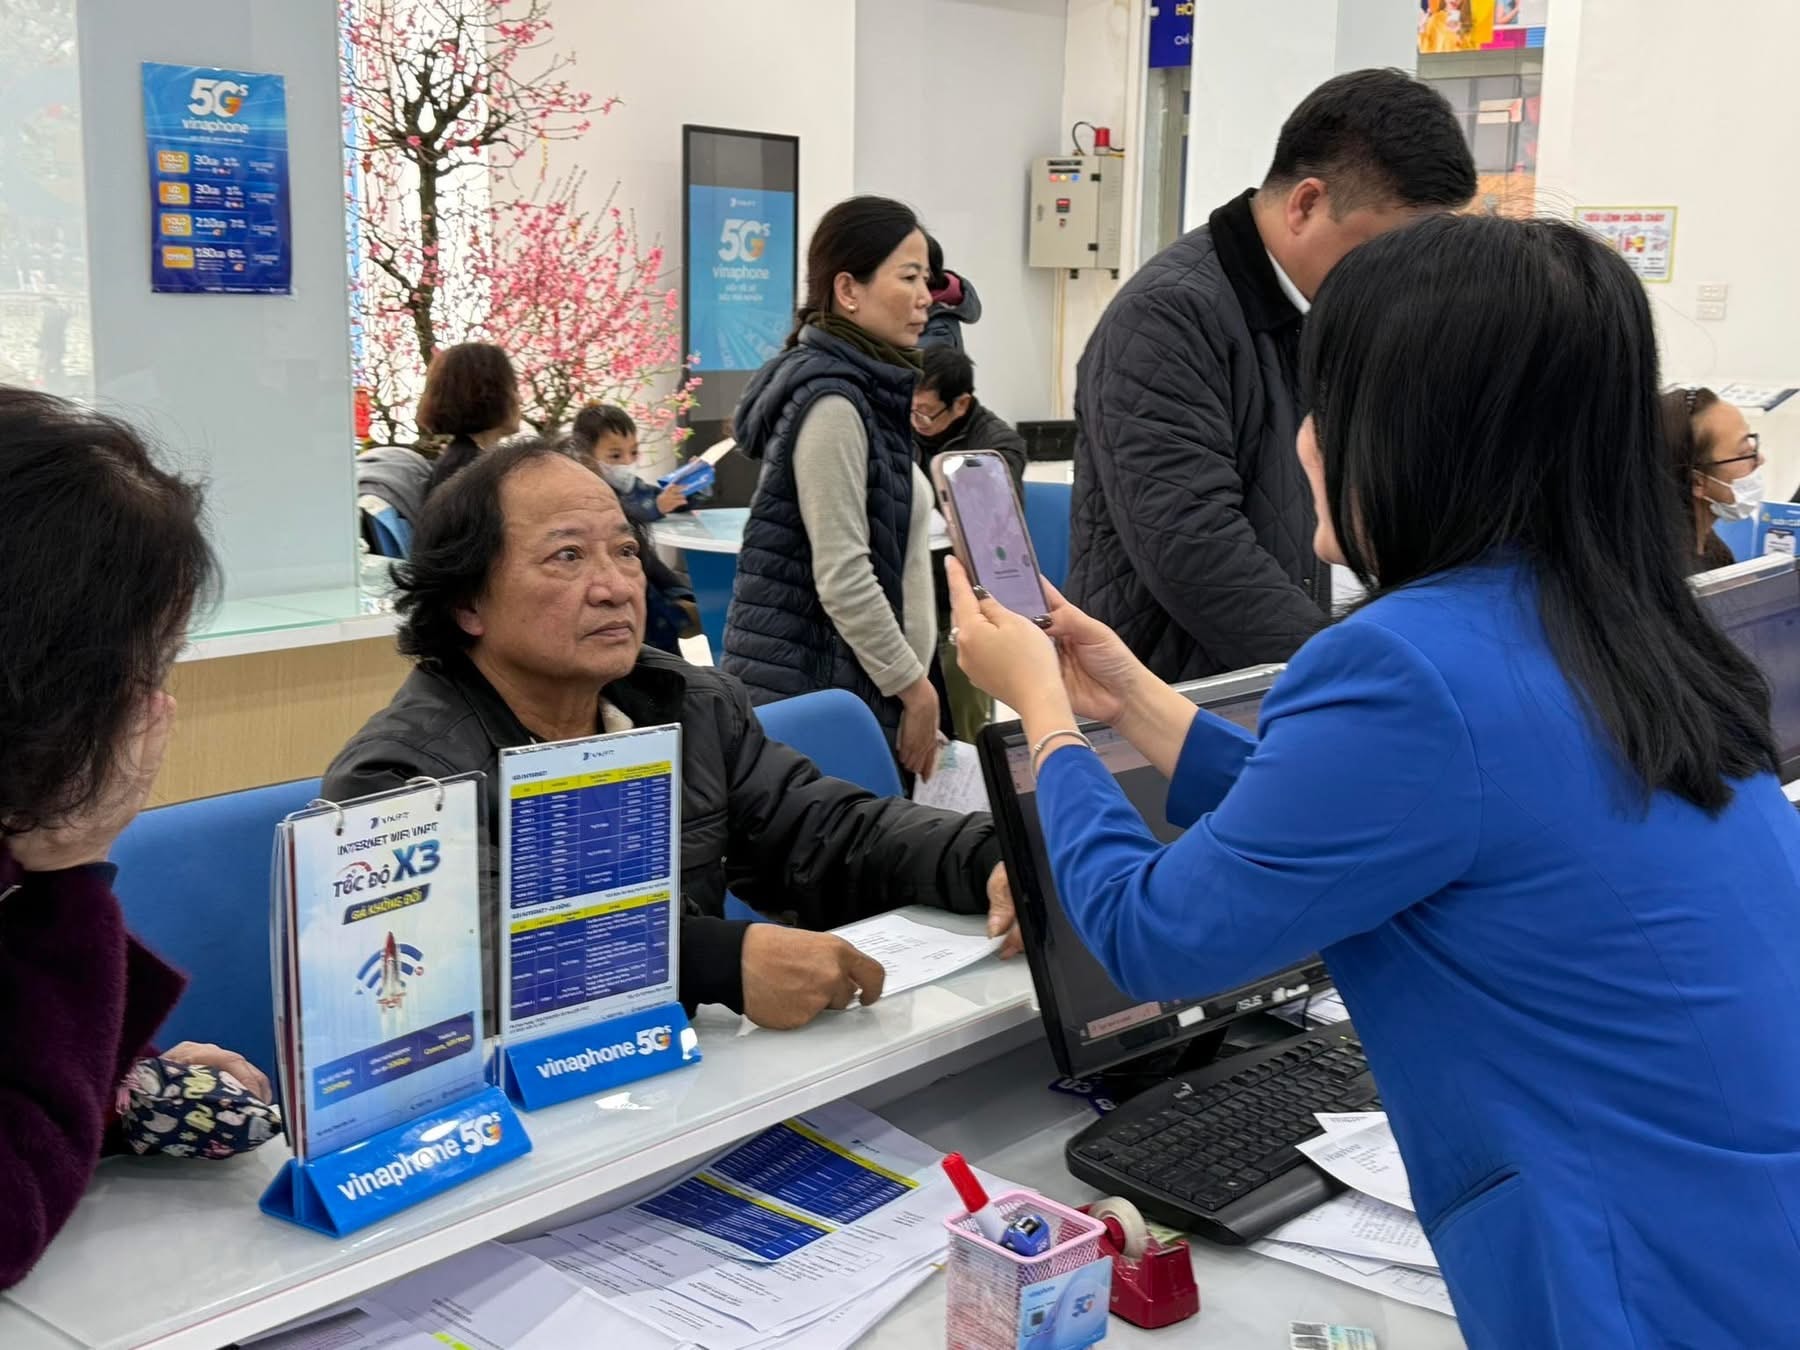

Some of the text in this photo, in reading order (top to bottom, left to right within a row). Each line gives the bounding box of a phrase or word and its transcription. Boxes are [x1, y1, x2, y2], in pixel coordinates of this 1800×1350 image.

[182, 117, 249, 134] vinaphone
[713, 264, 770, 281] vinaphone
[337, 835, 388, 855] INTERNET
[392, 839, 441, 882] X3
[536, 1042, 635, 1079] vinaphone
[337, 1139, 460, 1201] vinaphone
